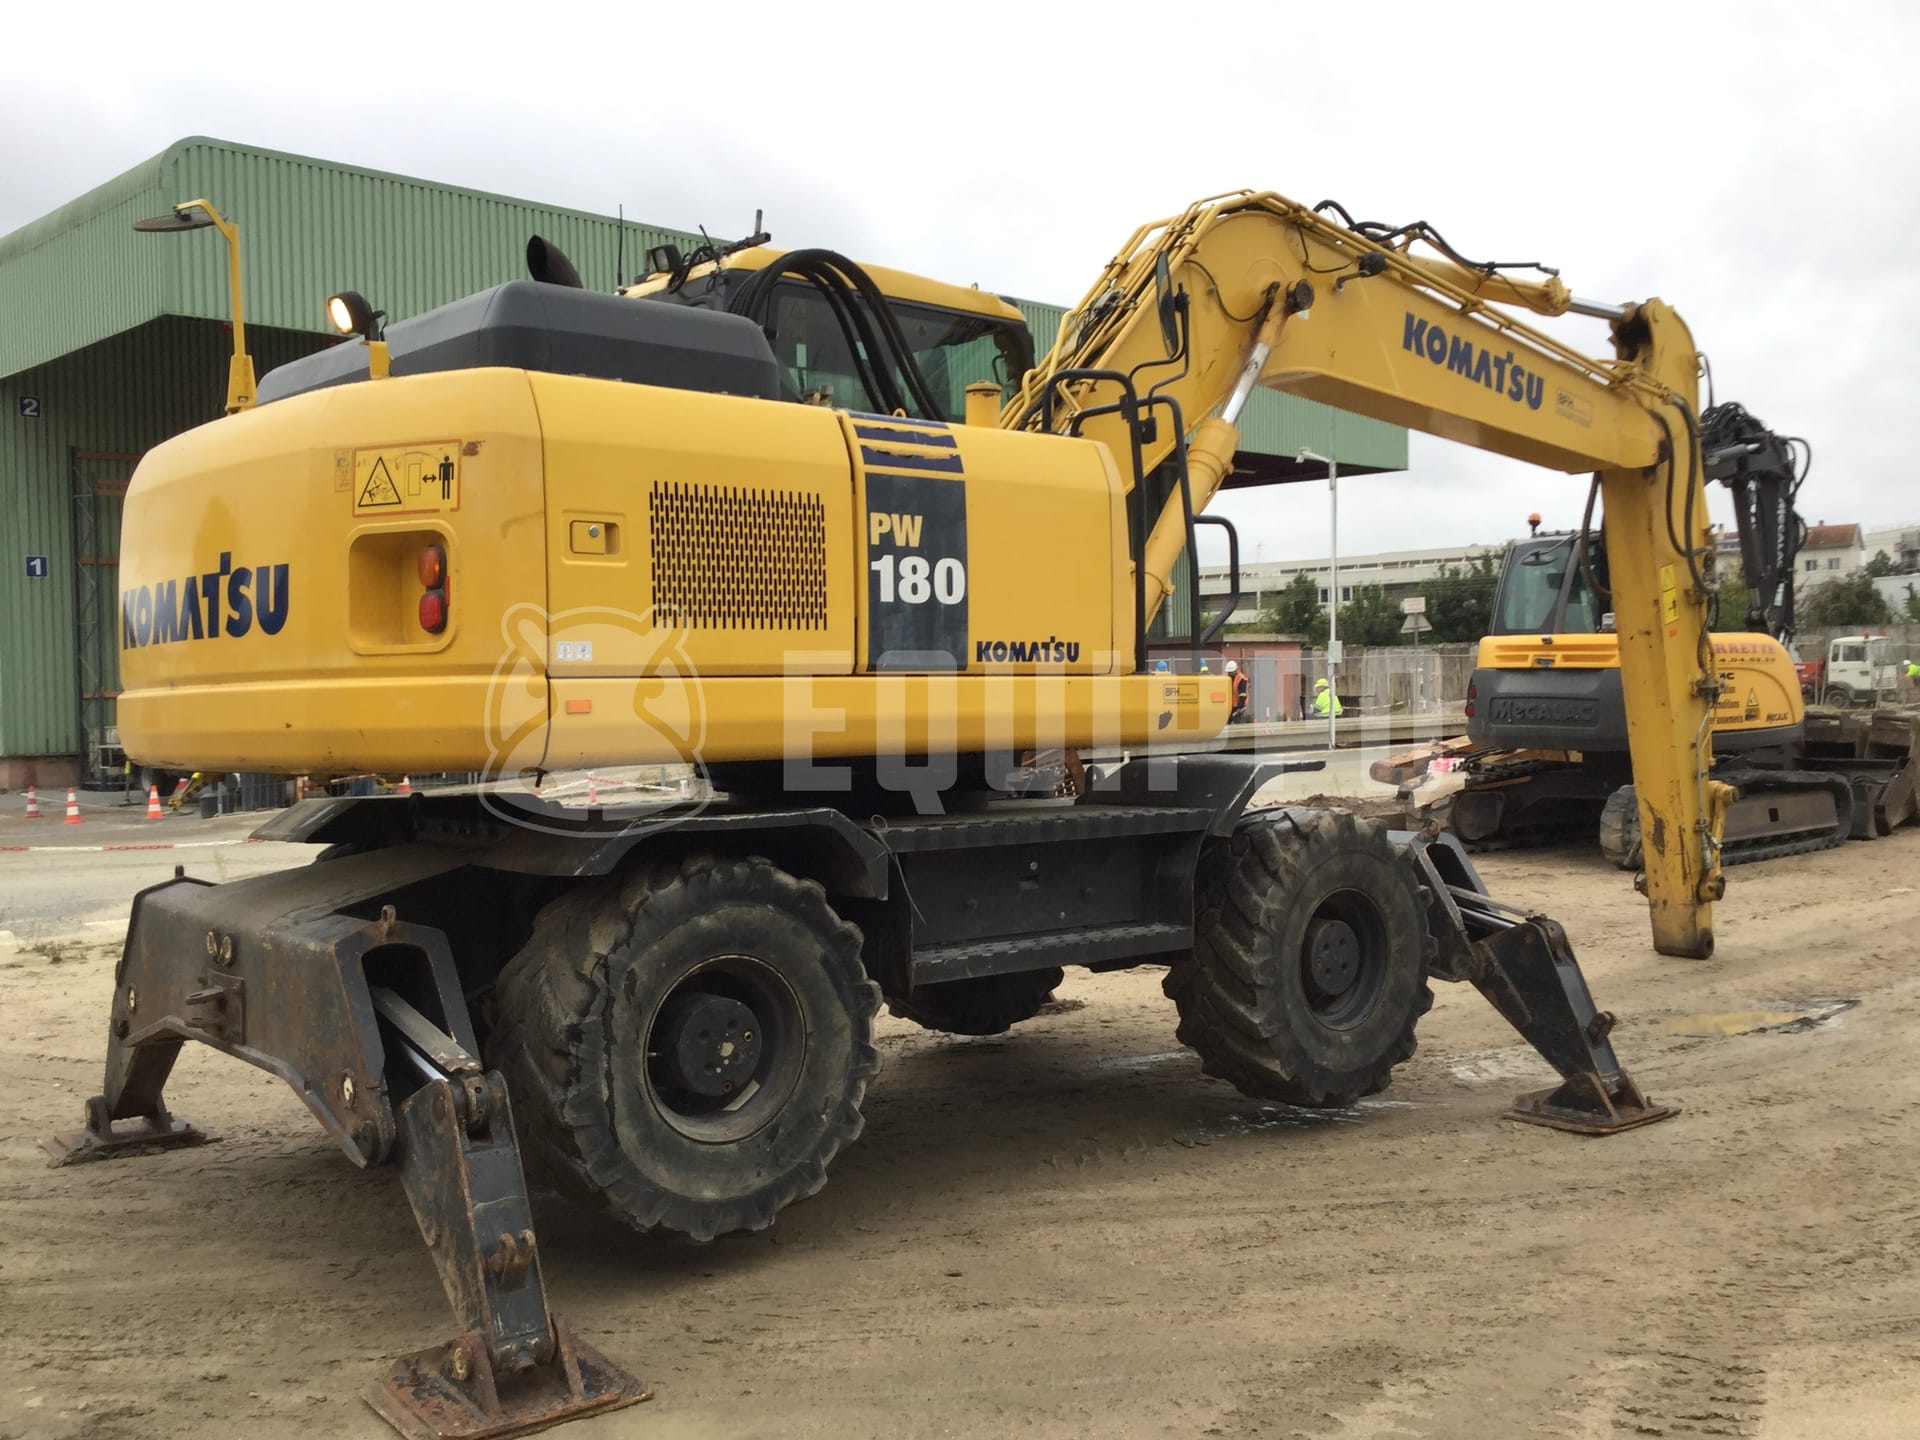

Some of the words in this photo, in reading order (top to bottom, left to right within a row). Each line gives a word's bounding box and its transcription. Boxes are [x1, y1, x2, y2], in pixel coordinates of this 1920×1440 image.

[1402, 311, 1545, 410] KOMATSU
[22, 398, 39, 417] 2
[869, 512, 923, 548] PW
[29, 558, 42, 577] 1
[870, 554, 966, 605] 180
[122, 550, 290, 651] KOMATSU
[976, 635, 1080, 663] KOMATSU
